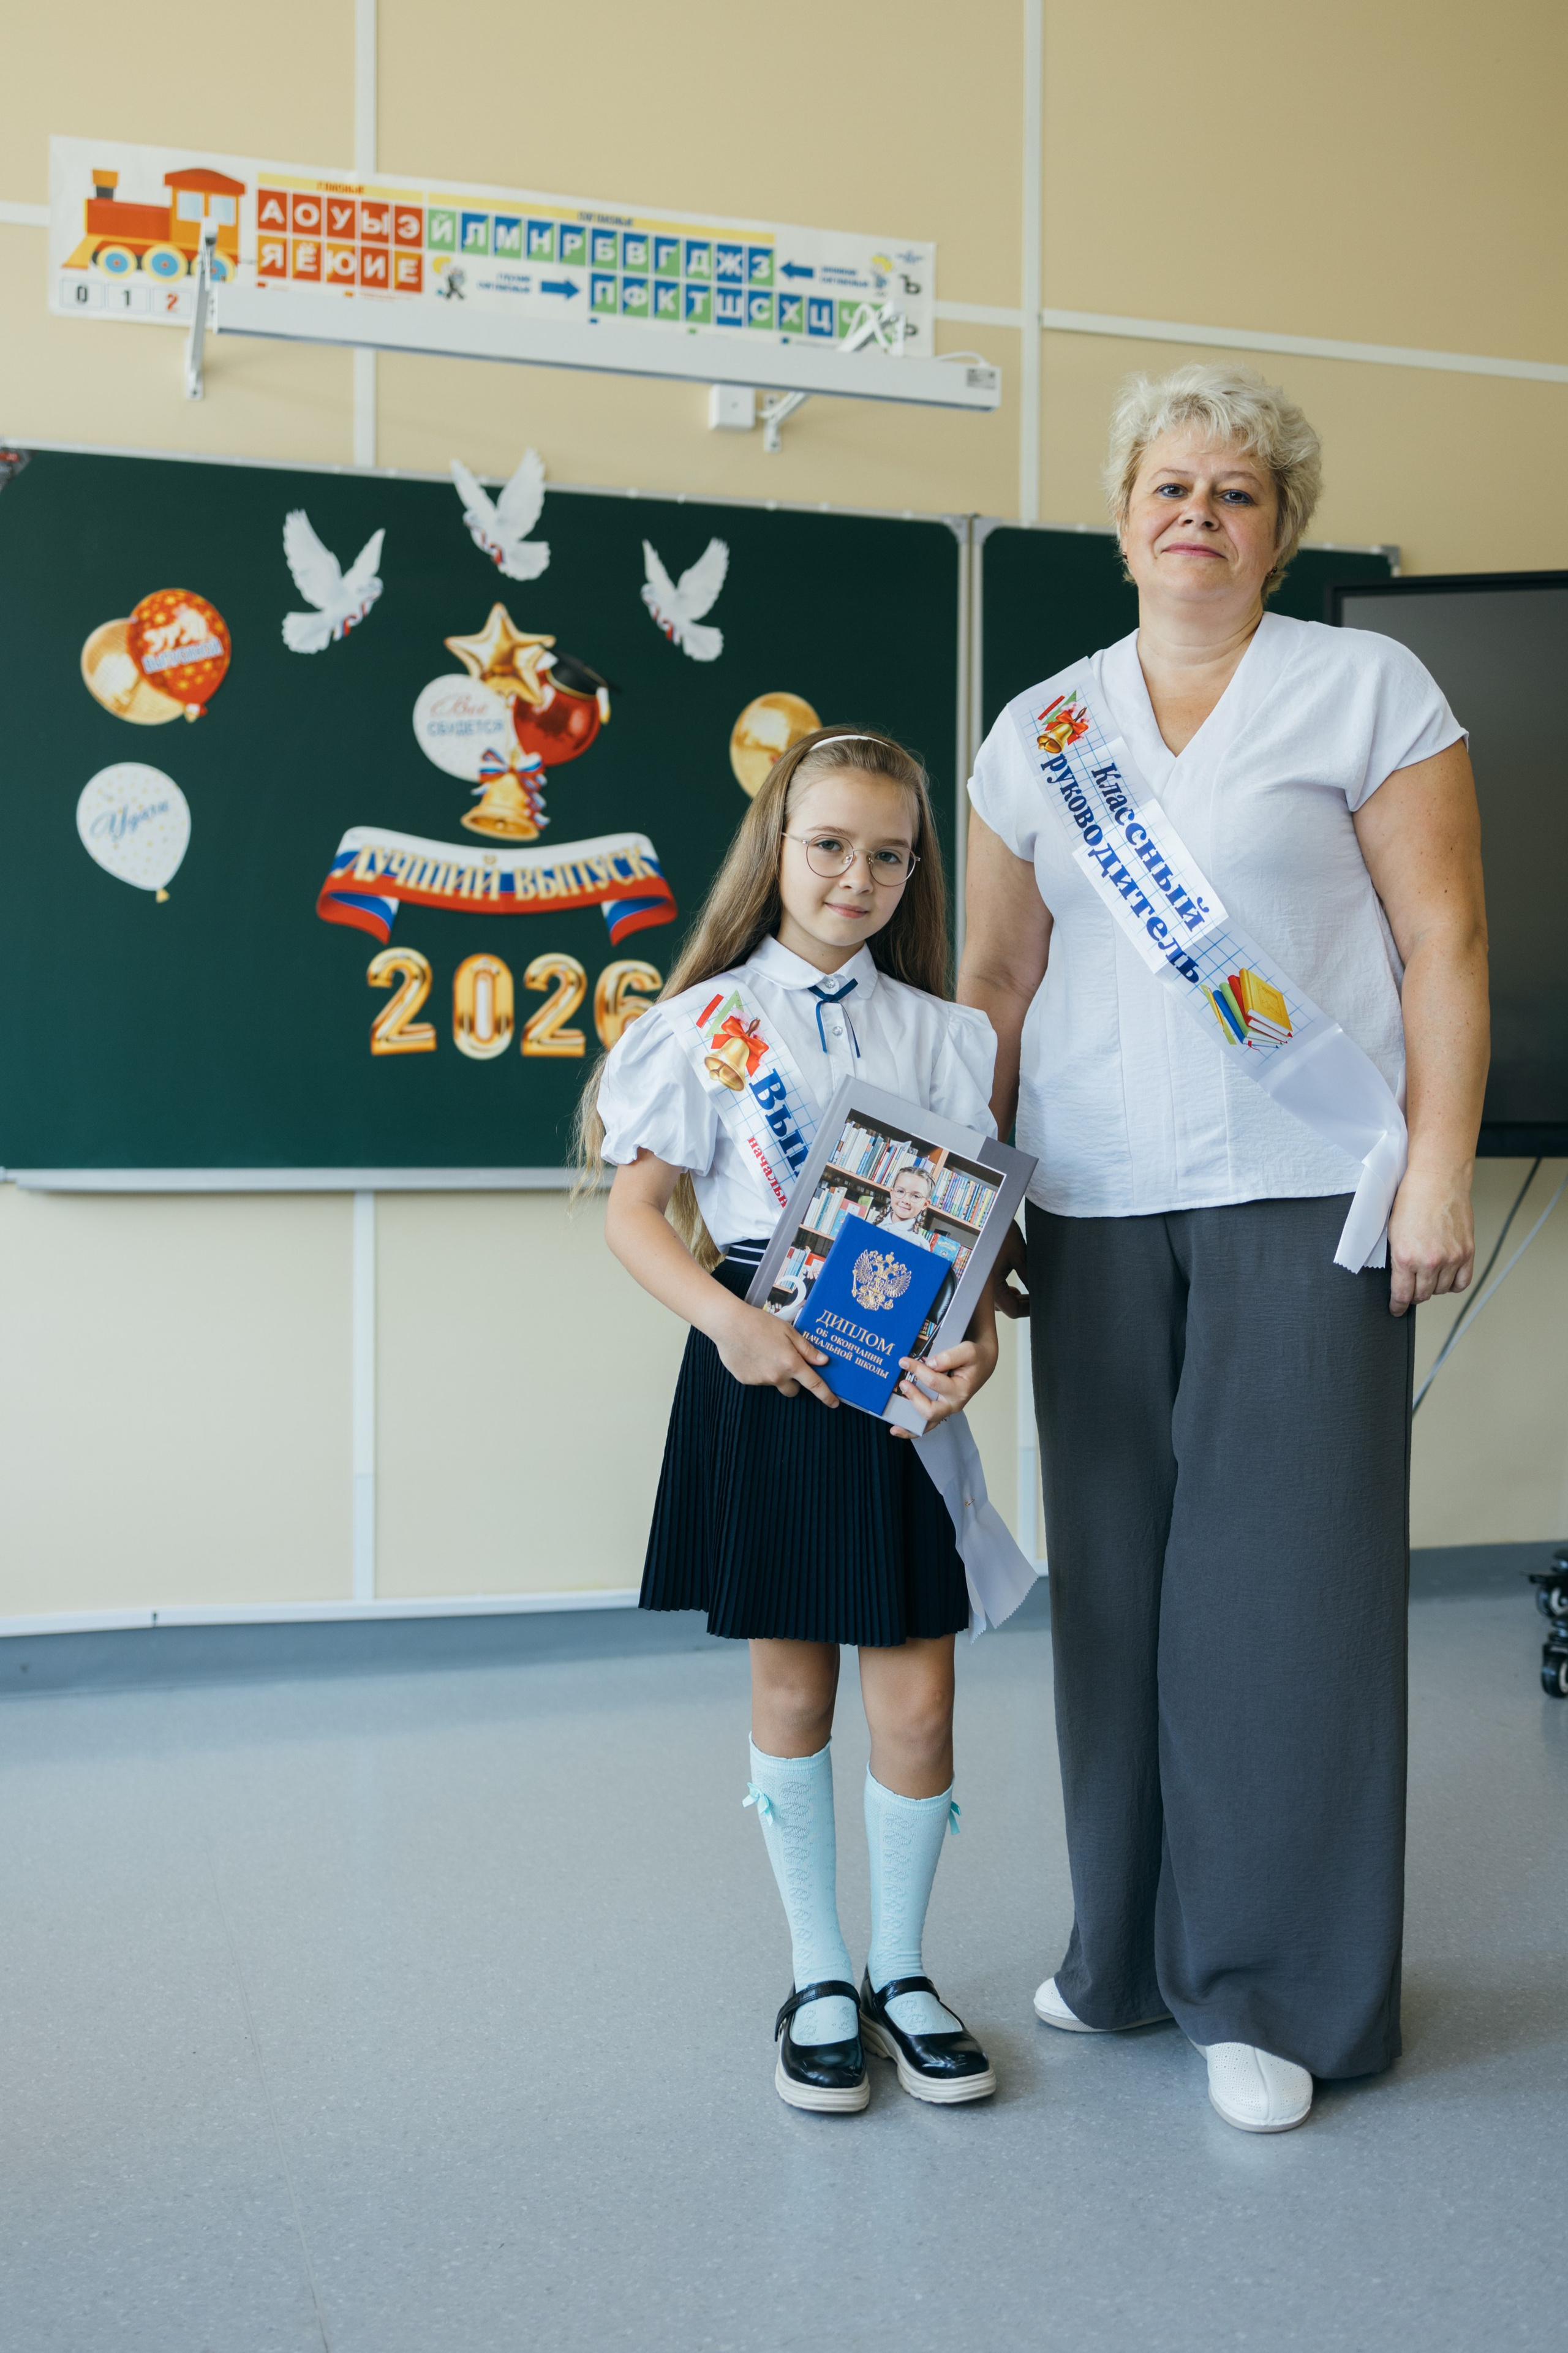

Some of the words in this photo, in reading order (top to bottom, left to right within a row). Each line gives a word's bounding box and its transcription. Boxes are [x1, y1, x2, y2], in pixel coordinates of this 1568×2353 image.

[76, 285, 88, 303] 0
[122, 289, 130, 306] 1
[167, 293, 179, 312] 2
[900, 274, 921, 295] Ъ
[1040, 753, 1199, 984] руководитель
[1091, 762, 1210, 932] Классный
[333, 845, 500, 902] ЛУЧШИЙ
[514, 845, 659, 901] ВЫПУСК
[367, 946, 663, 1060] 2026
[802, 1331, 853, 1361] НАЧАЛЬНОЙ
[854, 1357, 889, 1379] ШКОЛЫ
[815, 1309, 895, 1356] ДИПЛОМ
[816, 1327, 829, 1338] ОБ
[831, 1334, 884, 1365] ОКОНЧАНИИ
